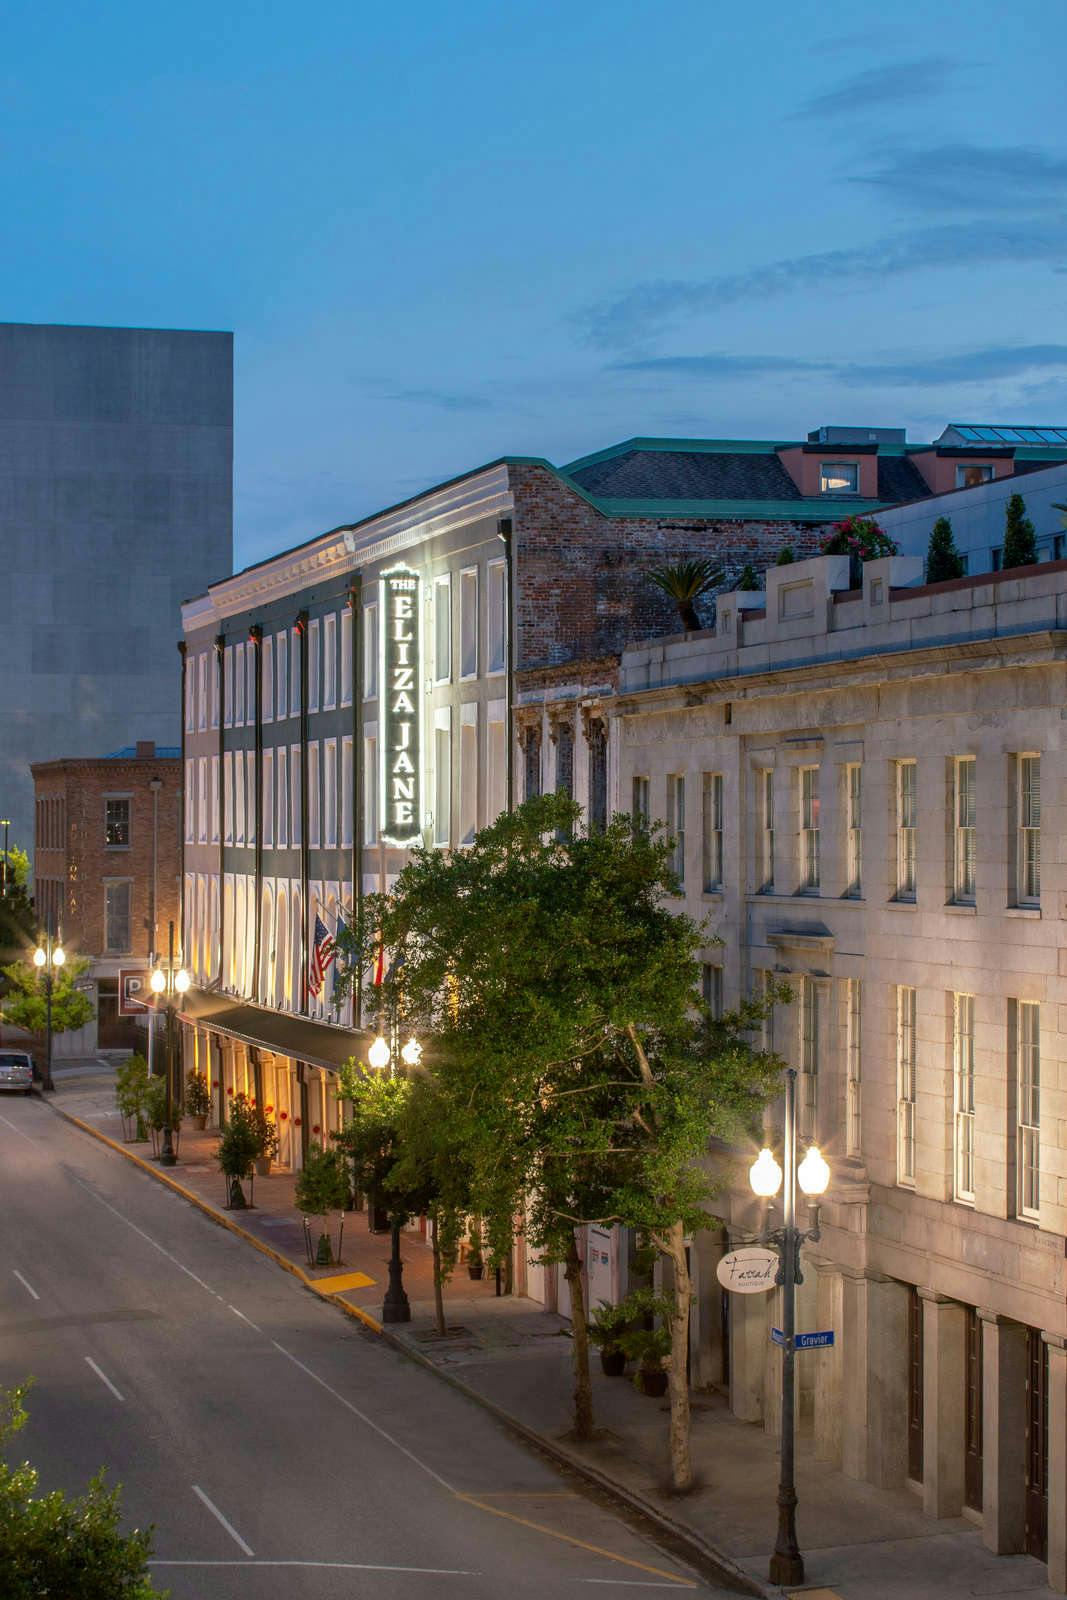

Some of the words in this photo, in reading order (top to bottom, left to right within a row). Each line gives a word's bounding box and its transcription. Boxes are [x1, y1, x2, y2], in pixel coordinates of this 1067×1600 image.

[390, 579, 416, 590] THE
[391, 596, 415, 714] ELIZA
[391, 722, 415, 825] JANE
[801, 1334, 829, 1346] Gravier
